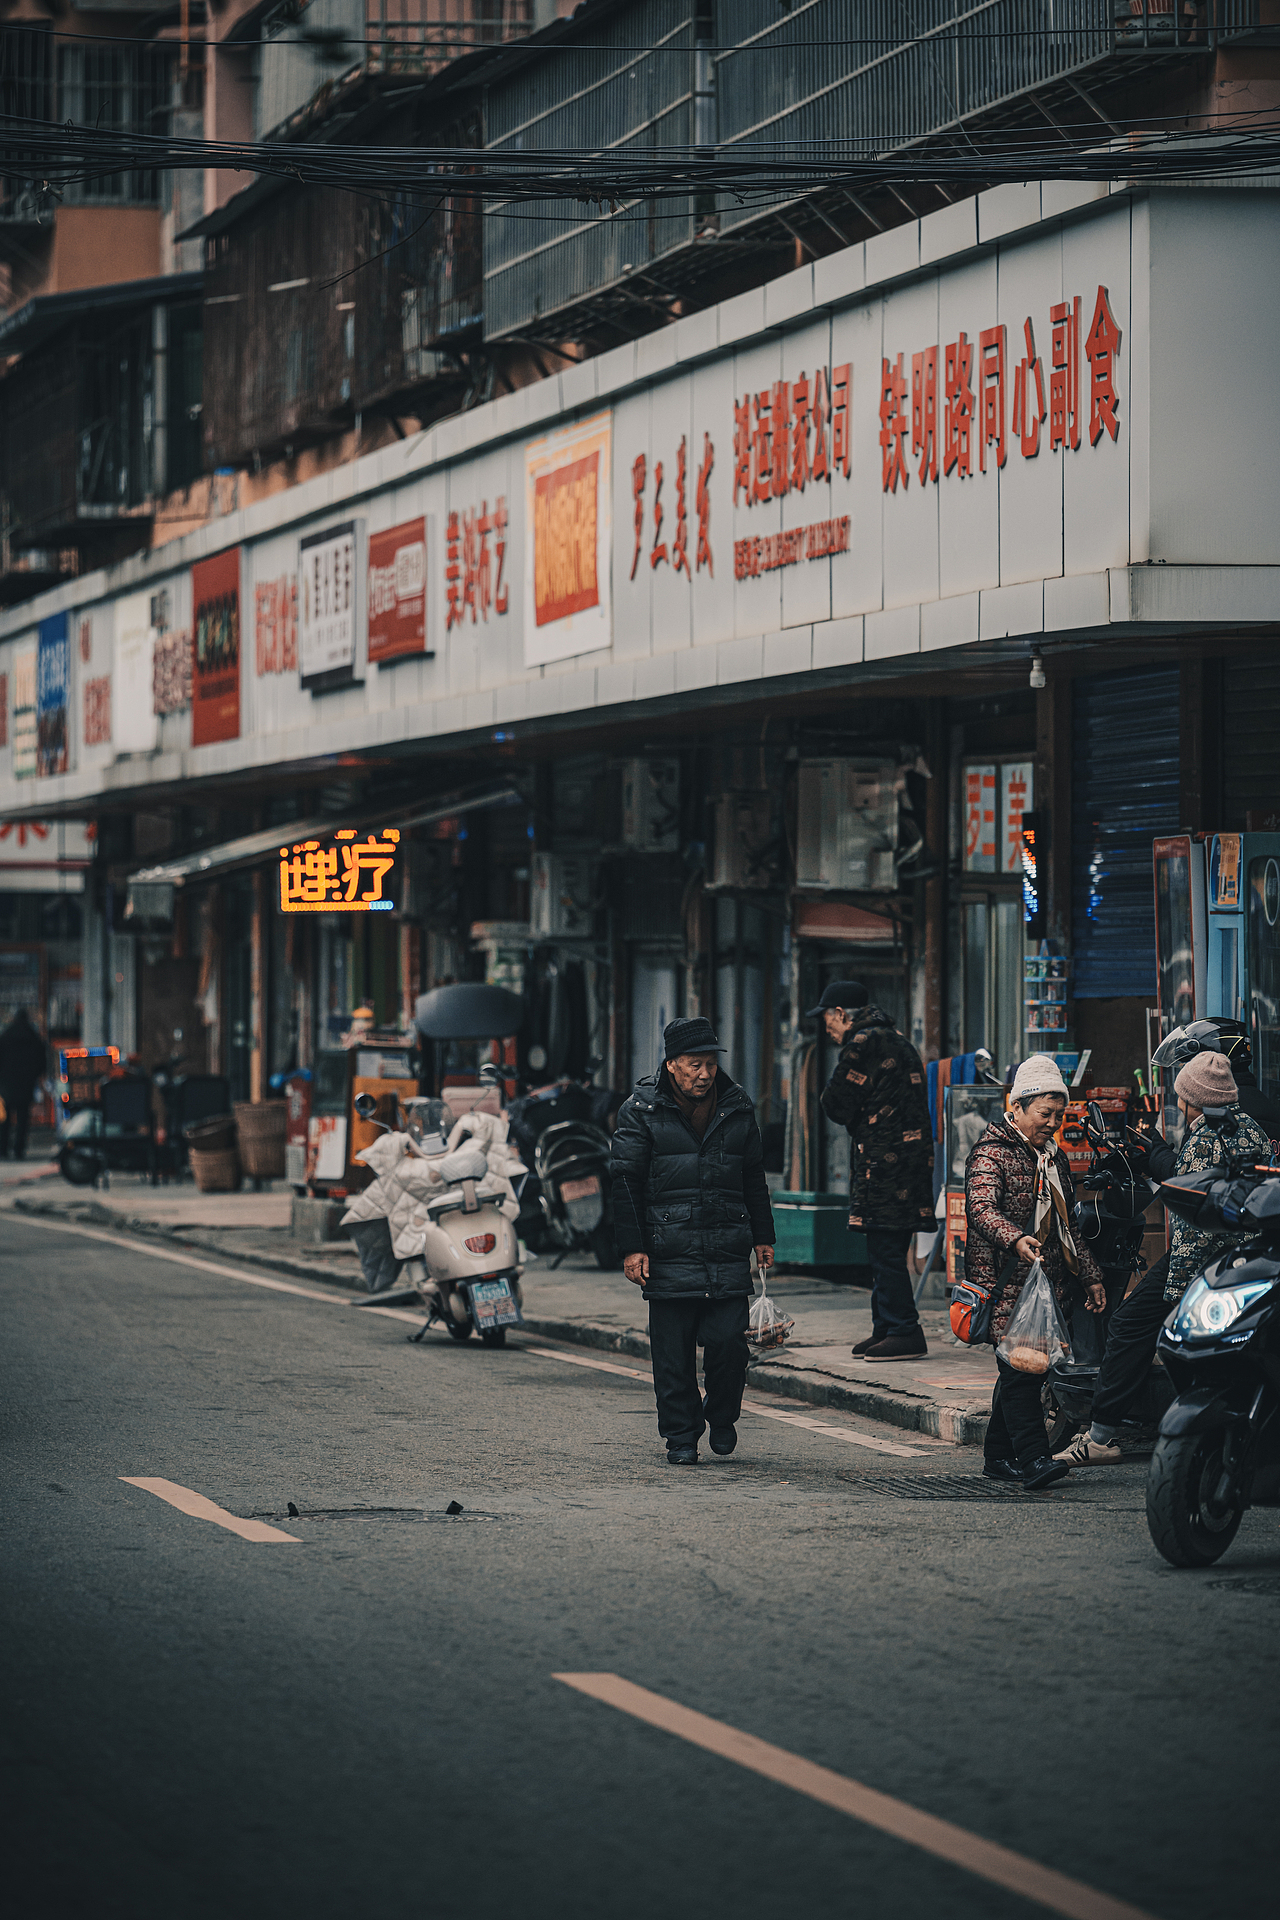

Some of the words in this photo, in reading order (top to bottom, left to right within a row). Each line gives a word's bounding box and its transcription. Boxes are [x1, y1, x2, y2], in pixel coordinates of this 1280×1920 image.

[879, 285, 1122, 493] 铁明路同心副食
